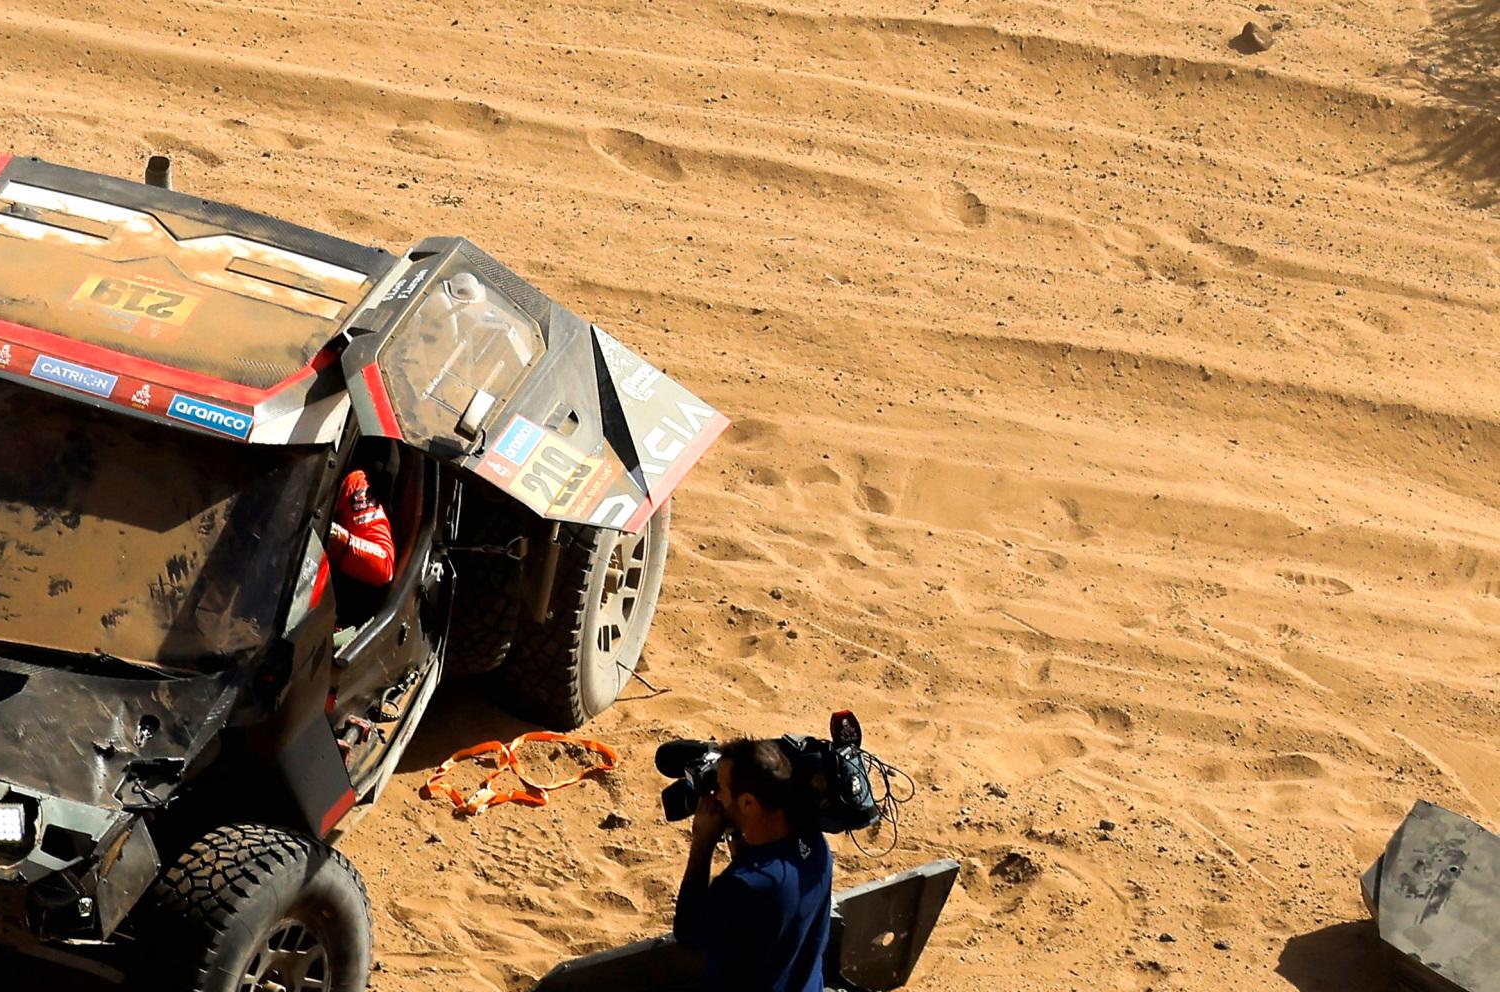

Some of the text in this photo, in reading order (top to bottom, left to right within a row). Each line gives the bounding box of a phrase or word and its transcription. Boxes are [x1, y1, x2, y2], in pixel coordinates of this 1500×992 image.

[89, 279, 186, 319] 219
[174, 400, 247, 431] aramco
[504, 424, 535, 459] aramco
[520, 446, 593, 507] 219
